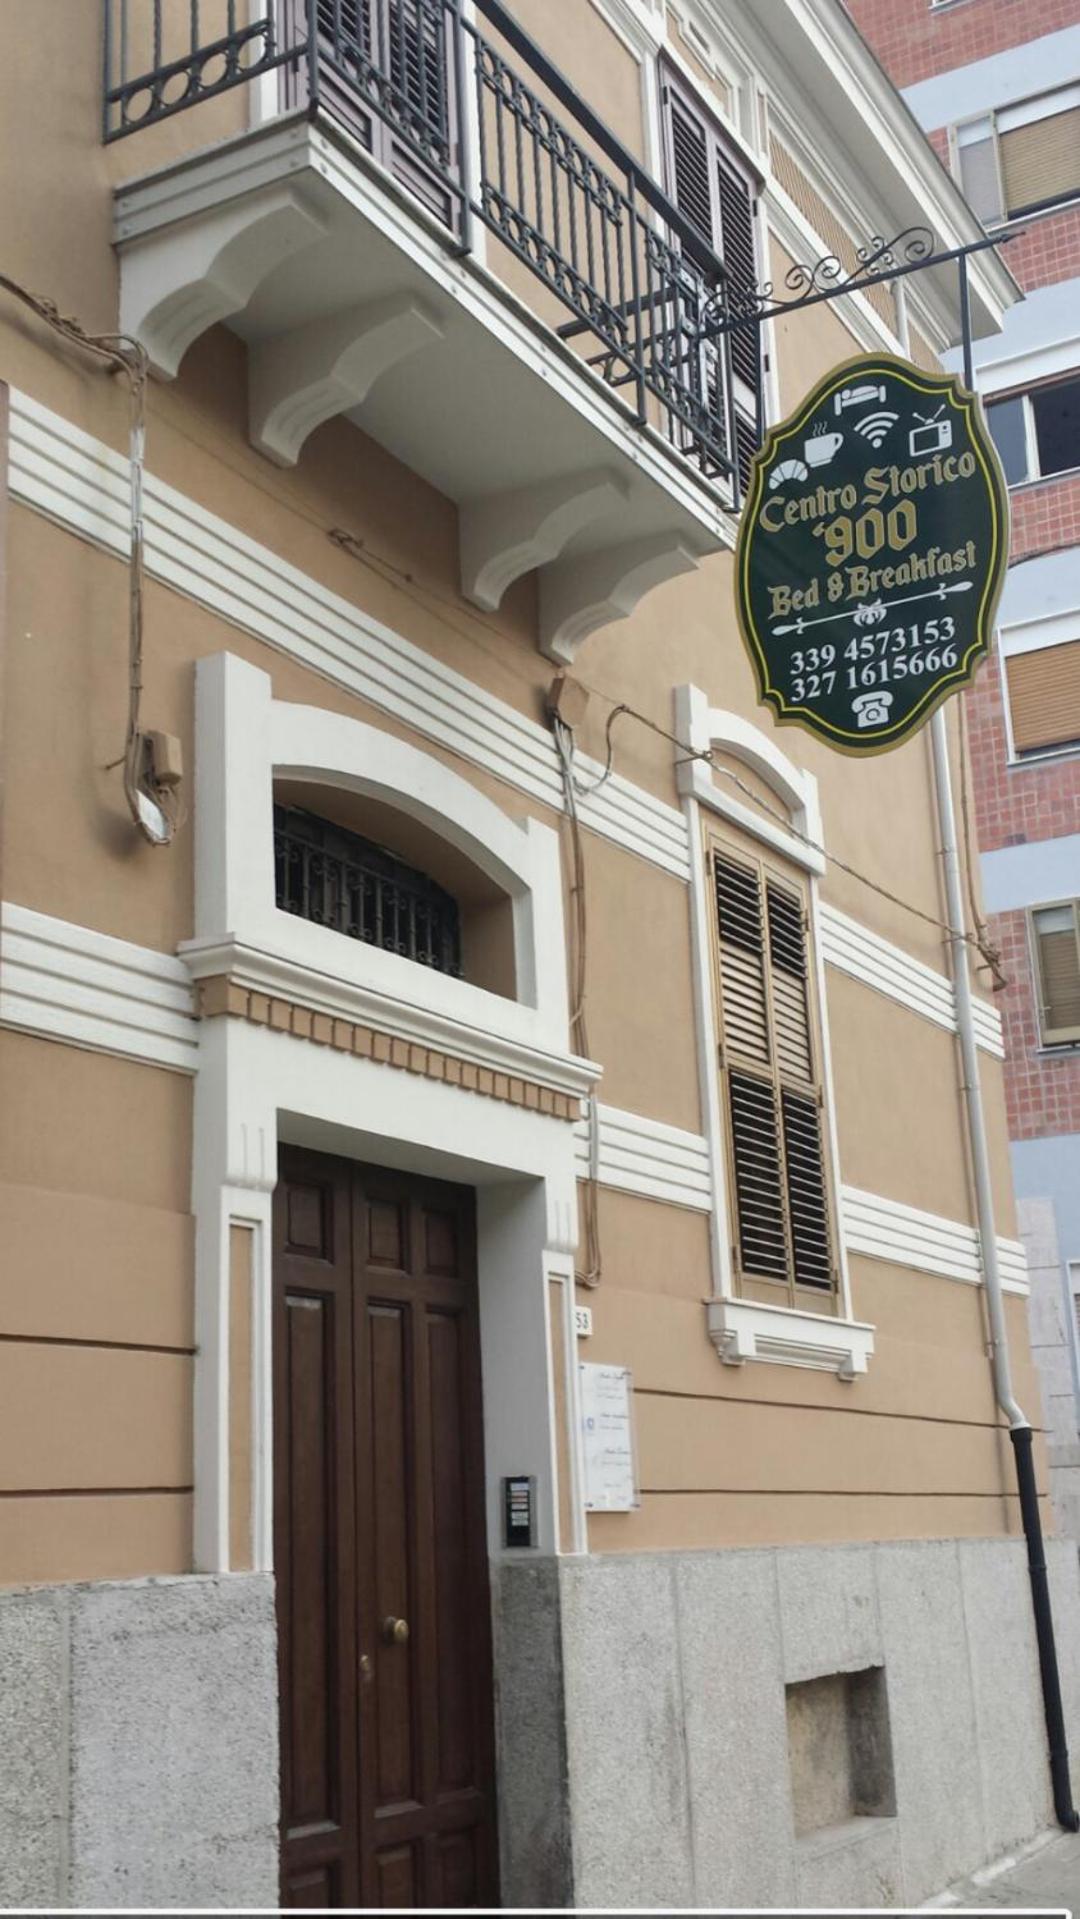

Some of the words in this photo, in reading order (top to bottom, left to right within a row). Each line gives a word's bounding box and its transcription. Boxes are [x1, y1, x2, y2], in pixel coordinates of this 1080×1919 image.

[759, 483, 857, 532] Centro
[862, 452, 976, 506] Storico
[768, 578, 819, 619] Bed
[845, 541, 976, 601] Breakfast
[790, 644, 835, 675] 339
[844, 617, 956, 661] 4573153
[790, 671, 836, 702] 327
[846, 643, 957, 689] 1615666
